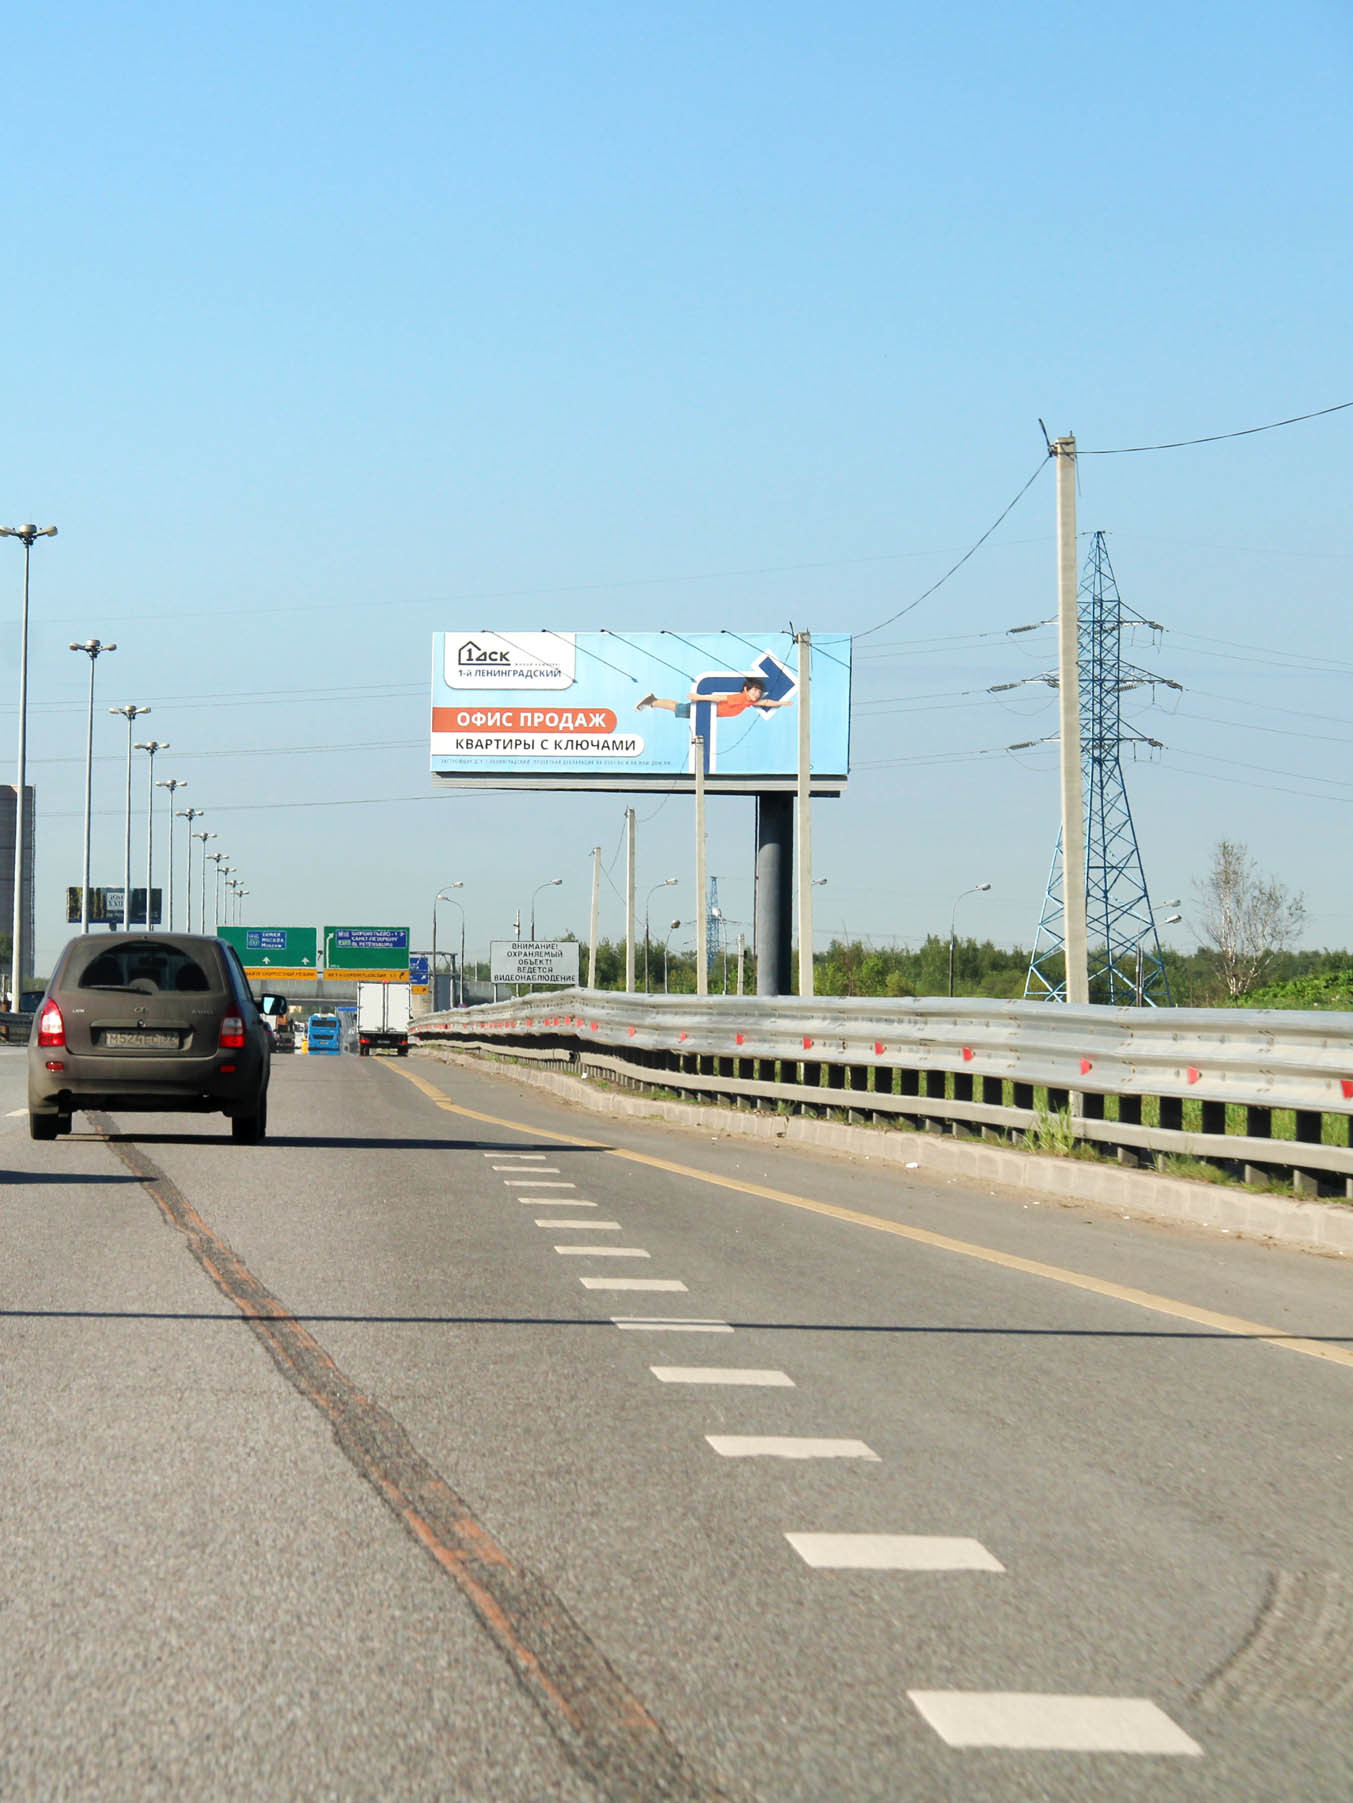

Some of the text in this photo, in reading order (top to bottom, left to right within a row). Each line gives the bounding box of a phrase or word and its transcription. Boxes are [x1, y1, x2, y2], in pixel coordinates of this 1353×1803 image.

[474, 668, 562, 679] ЛЕНИНГРАДСКИЙ
[456, 712, 607, 731] ОФИС ПРОДАЖ
[455, 738, 636, 751] КВАРТИРЫ С КЛЮЧАМИ
[506, 950, 563, 958] ОХРАНЯЕМЫЙ
[517, 966, 553, 974] ВЕДЕТСЯ
[494, 974, 576, 982] ВИДЕОНАБЛЮДЕНИЕ
